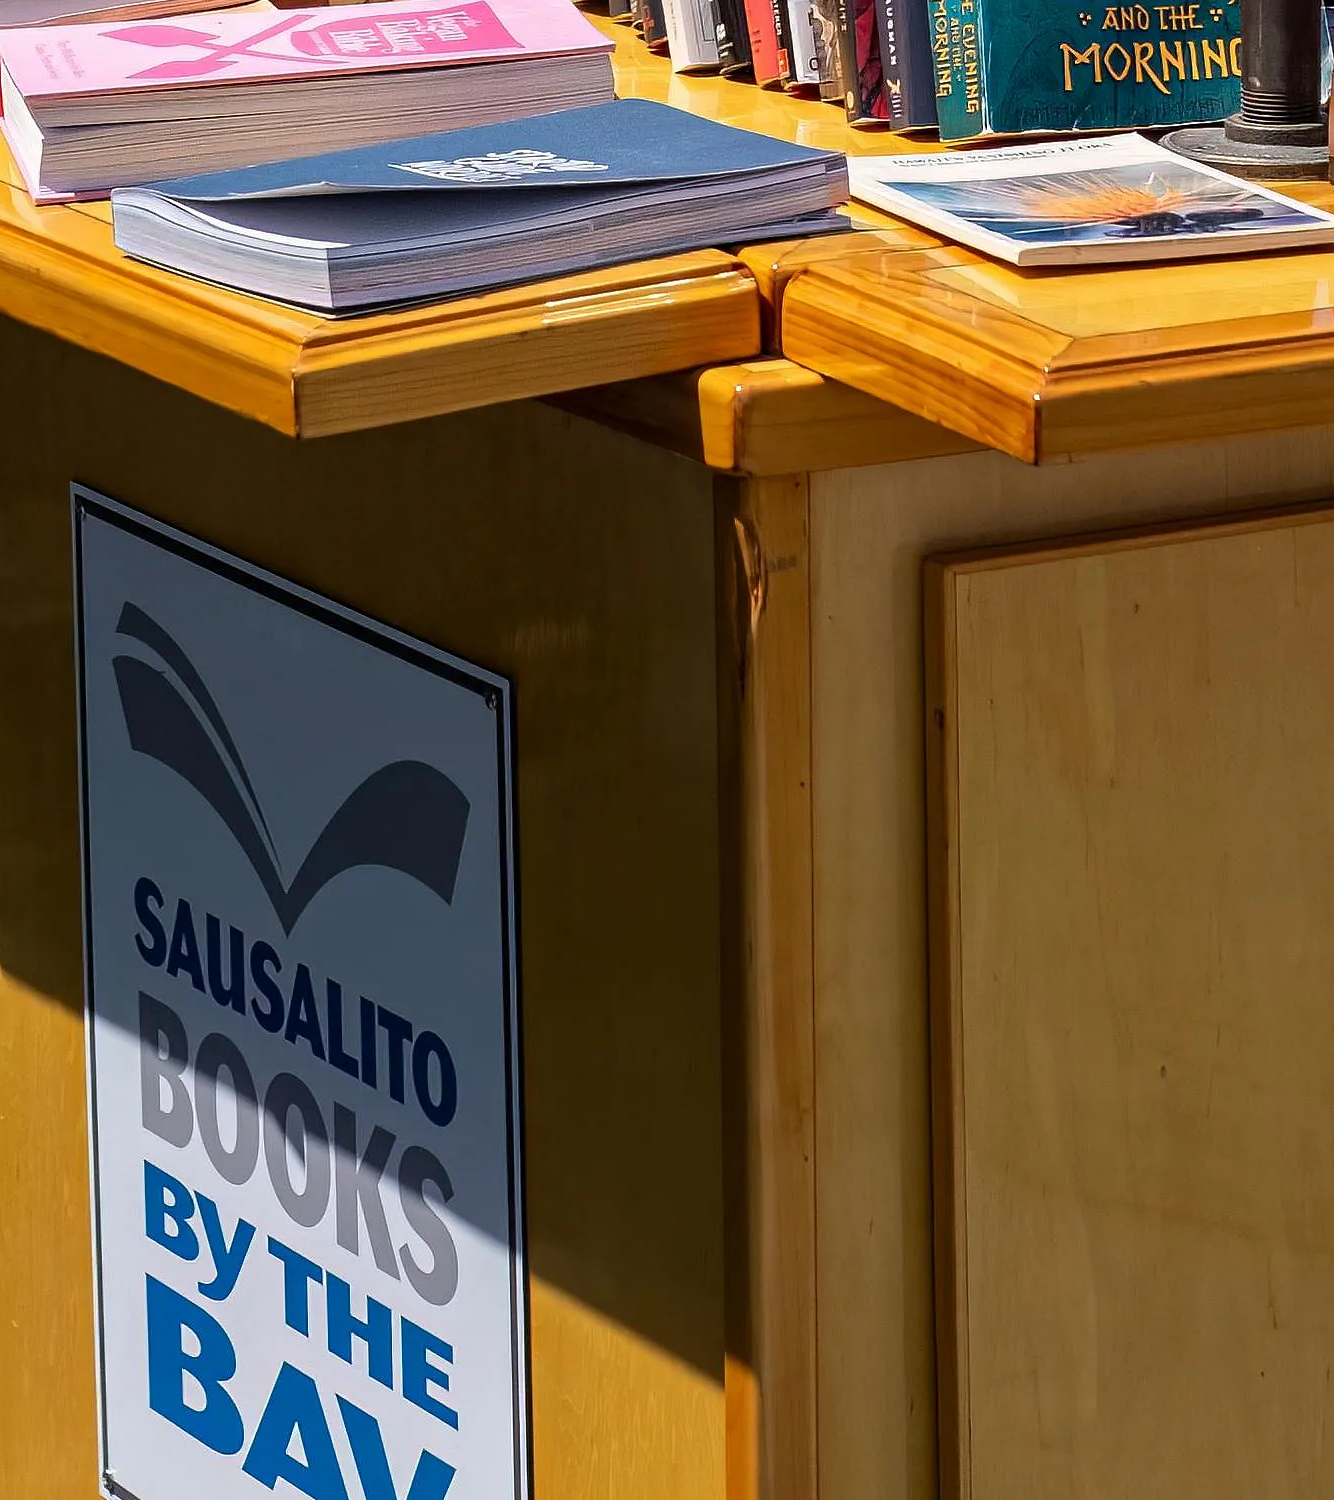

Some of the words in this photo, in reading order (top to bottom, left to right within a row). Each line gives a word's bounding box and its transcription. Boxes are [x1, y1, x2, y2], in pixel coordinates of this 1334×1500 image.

[328, 28, 383, 55] Bible
[374, 18, 427, 55] Baking
[417, 10, 471, 42] Vegan
[1101, 4, 1151, 31] AND
[1153, 3, 1204, 31] THE
[961, 22, 981, 114] EVENING
[133, 876, 458, 1128] SAUSALITO
[138, 989, 459, 1307] BOOKS
[267, 1234, 459, 1431] THE
